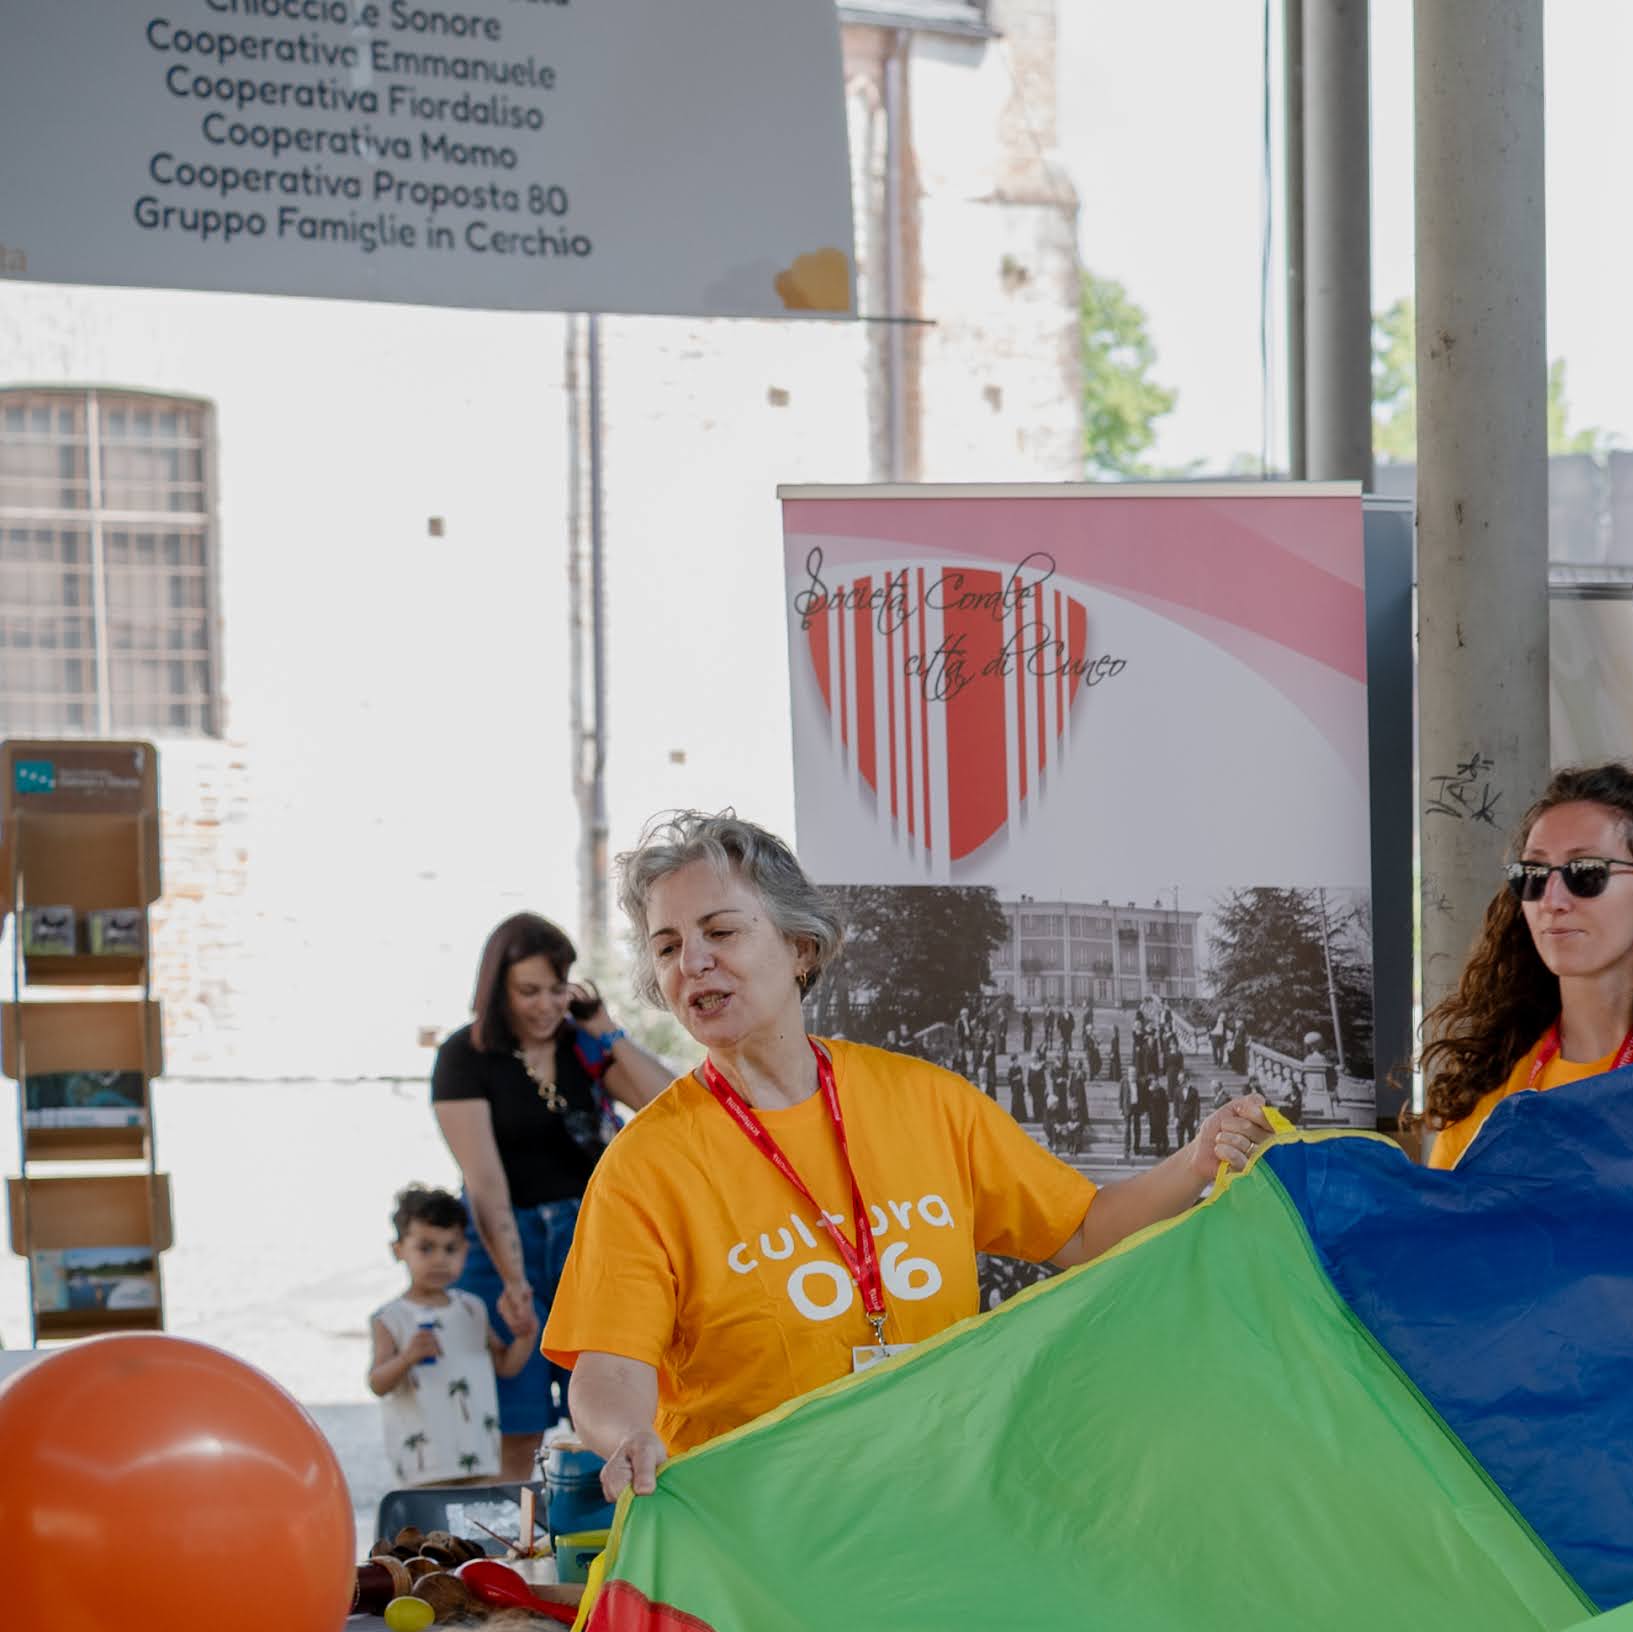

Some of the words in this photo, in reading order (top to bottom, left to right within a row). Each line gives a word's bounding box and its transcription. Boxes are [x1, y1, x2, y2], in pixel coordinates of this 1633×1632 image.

[391, 3, 501, 41] Sonore
[146, 19, 358, 68] Cooperativa
[371, 40, 556, 90] Emmanuele
[166, 65, 379, 114] Cooperativa
[388, 86, 544, 131] Fiordaliso
[202, 113, 411, 159] Cooperativa
[421, 133, 518, 169] Momo
[149, 153, 361, 199] Cooperativa
[374, 170, 520, 214] Proposta
[528, 184, 568, 216] 80
[134, 197, 266, 242] Gruppo
[278, 206, 416, 253] Famiglie
[427, 218, 455, 250] in
[465, 222, 593, 259] Cerchio
[925, 552, 1056, 621] Corale
[980, 621, 1050, 678] di
[1027, 639, 1127, 686] Cuneo
